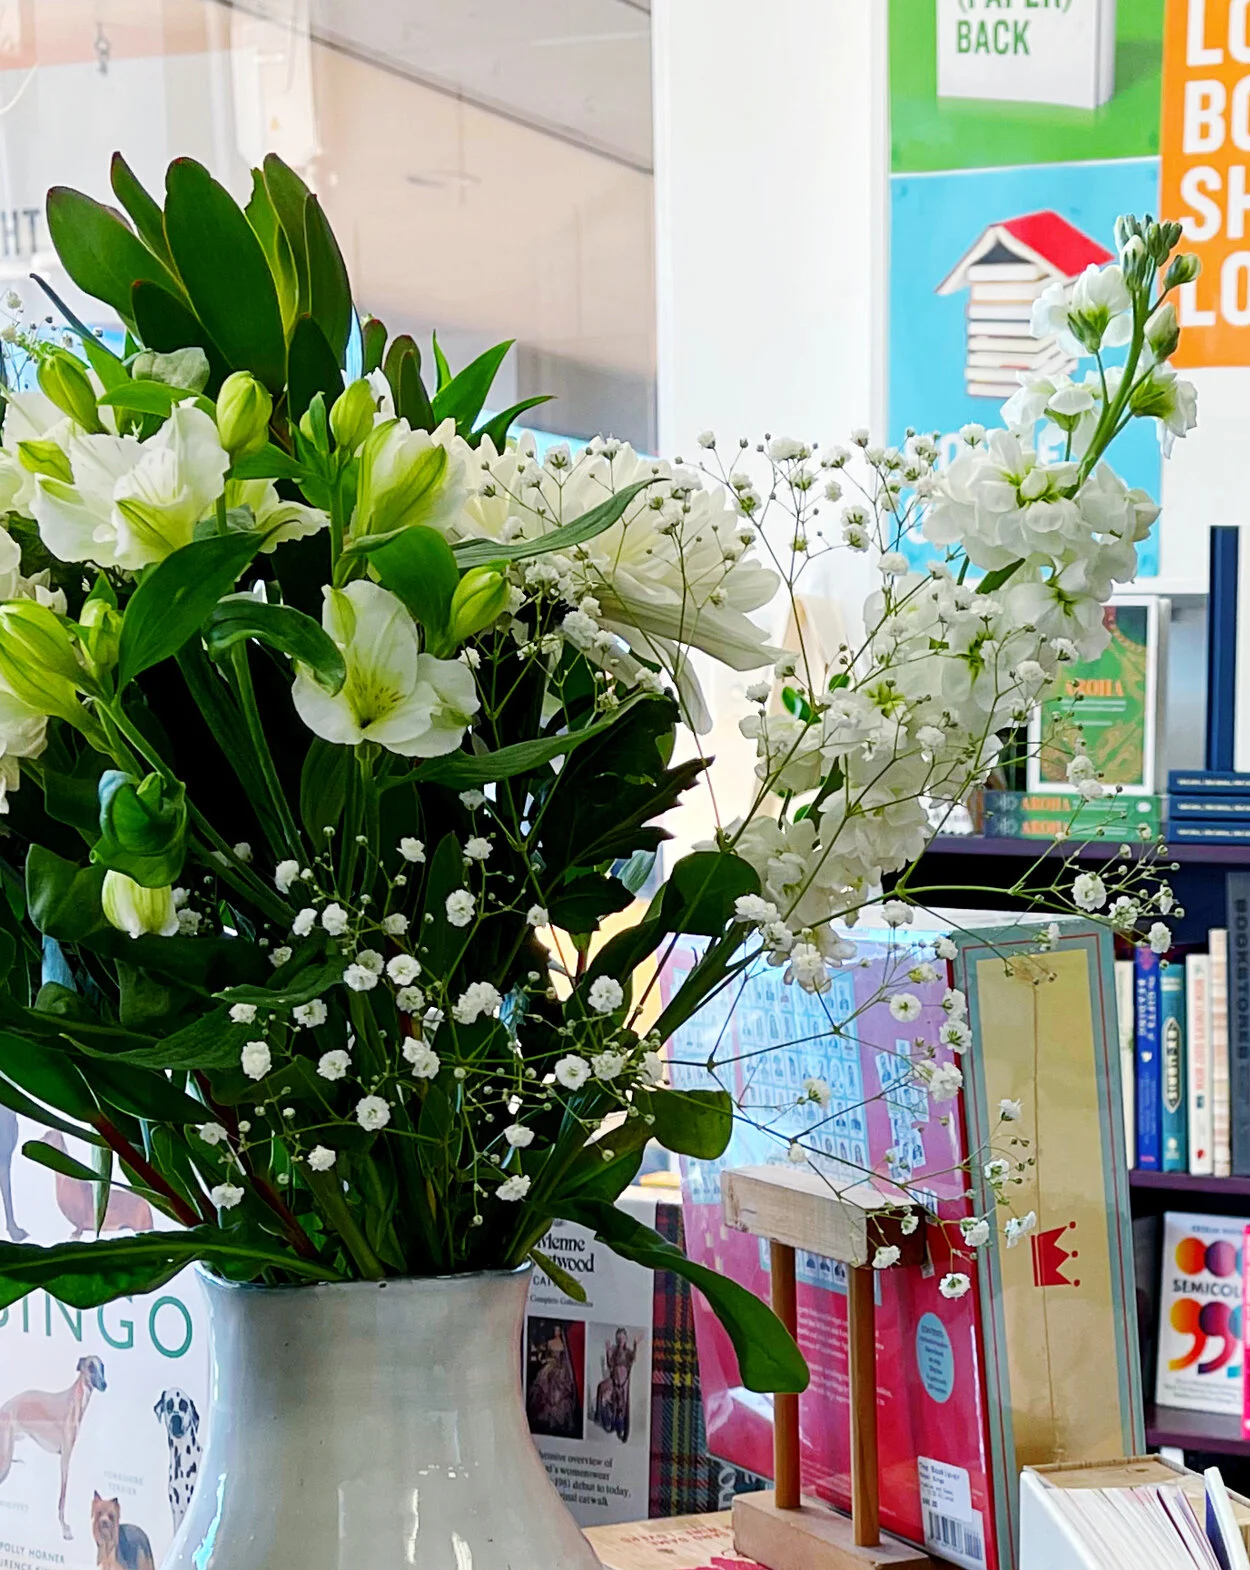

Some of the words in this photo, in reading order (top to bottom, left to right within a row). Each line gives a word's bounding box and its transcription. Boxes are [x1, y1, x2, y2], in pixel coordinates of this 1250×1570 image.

[957, 19, 1030, 55] BACK
[1233, 898, 1250, 1060] BOOKSTORES
[1173, 1278, 1241, 1298] SEMICOL
